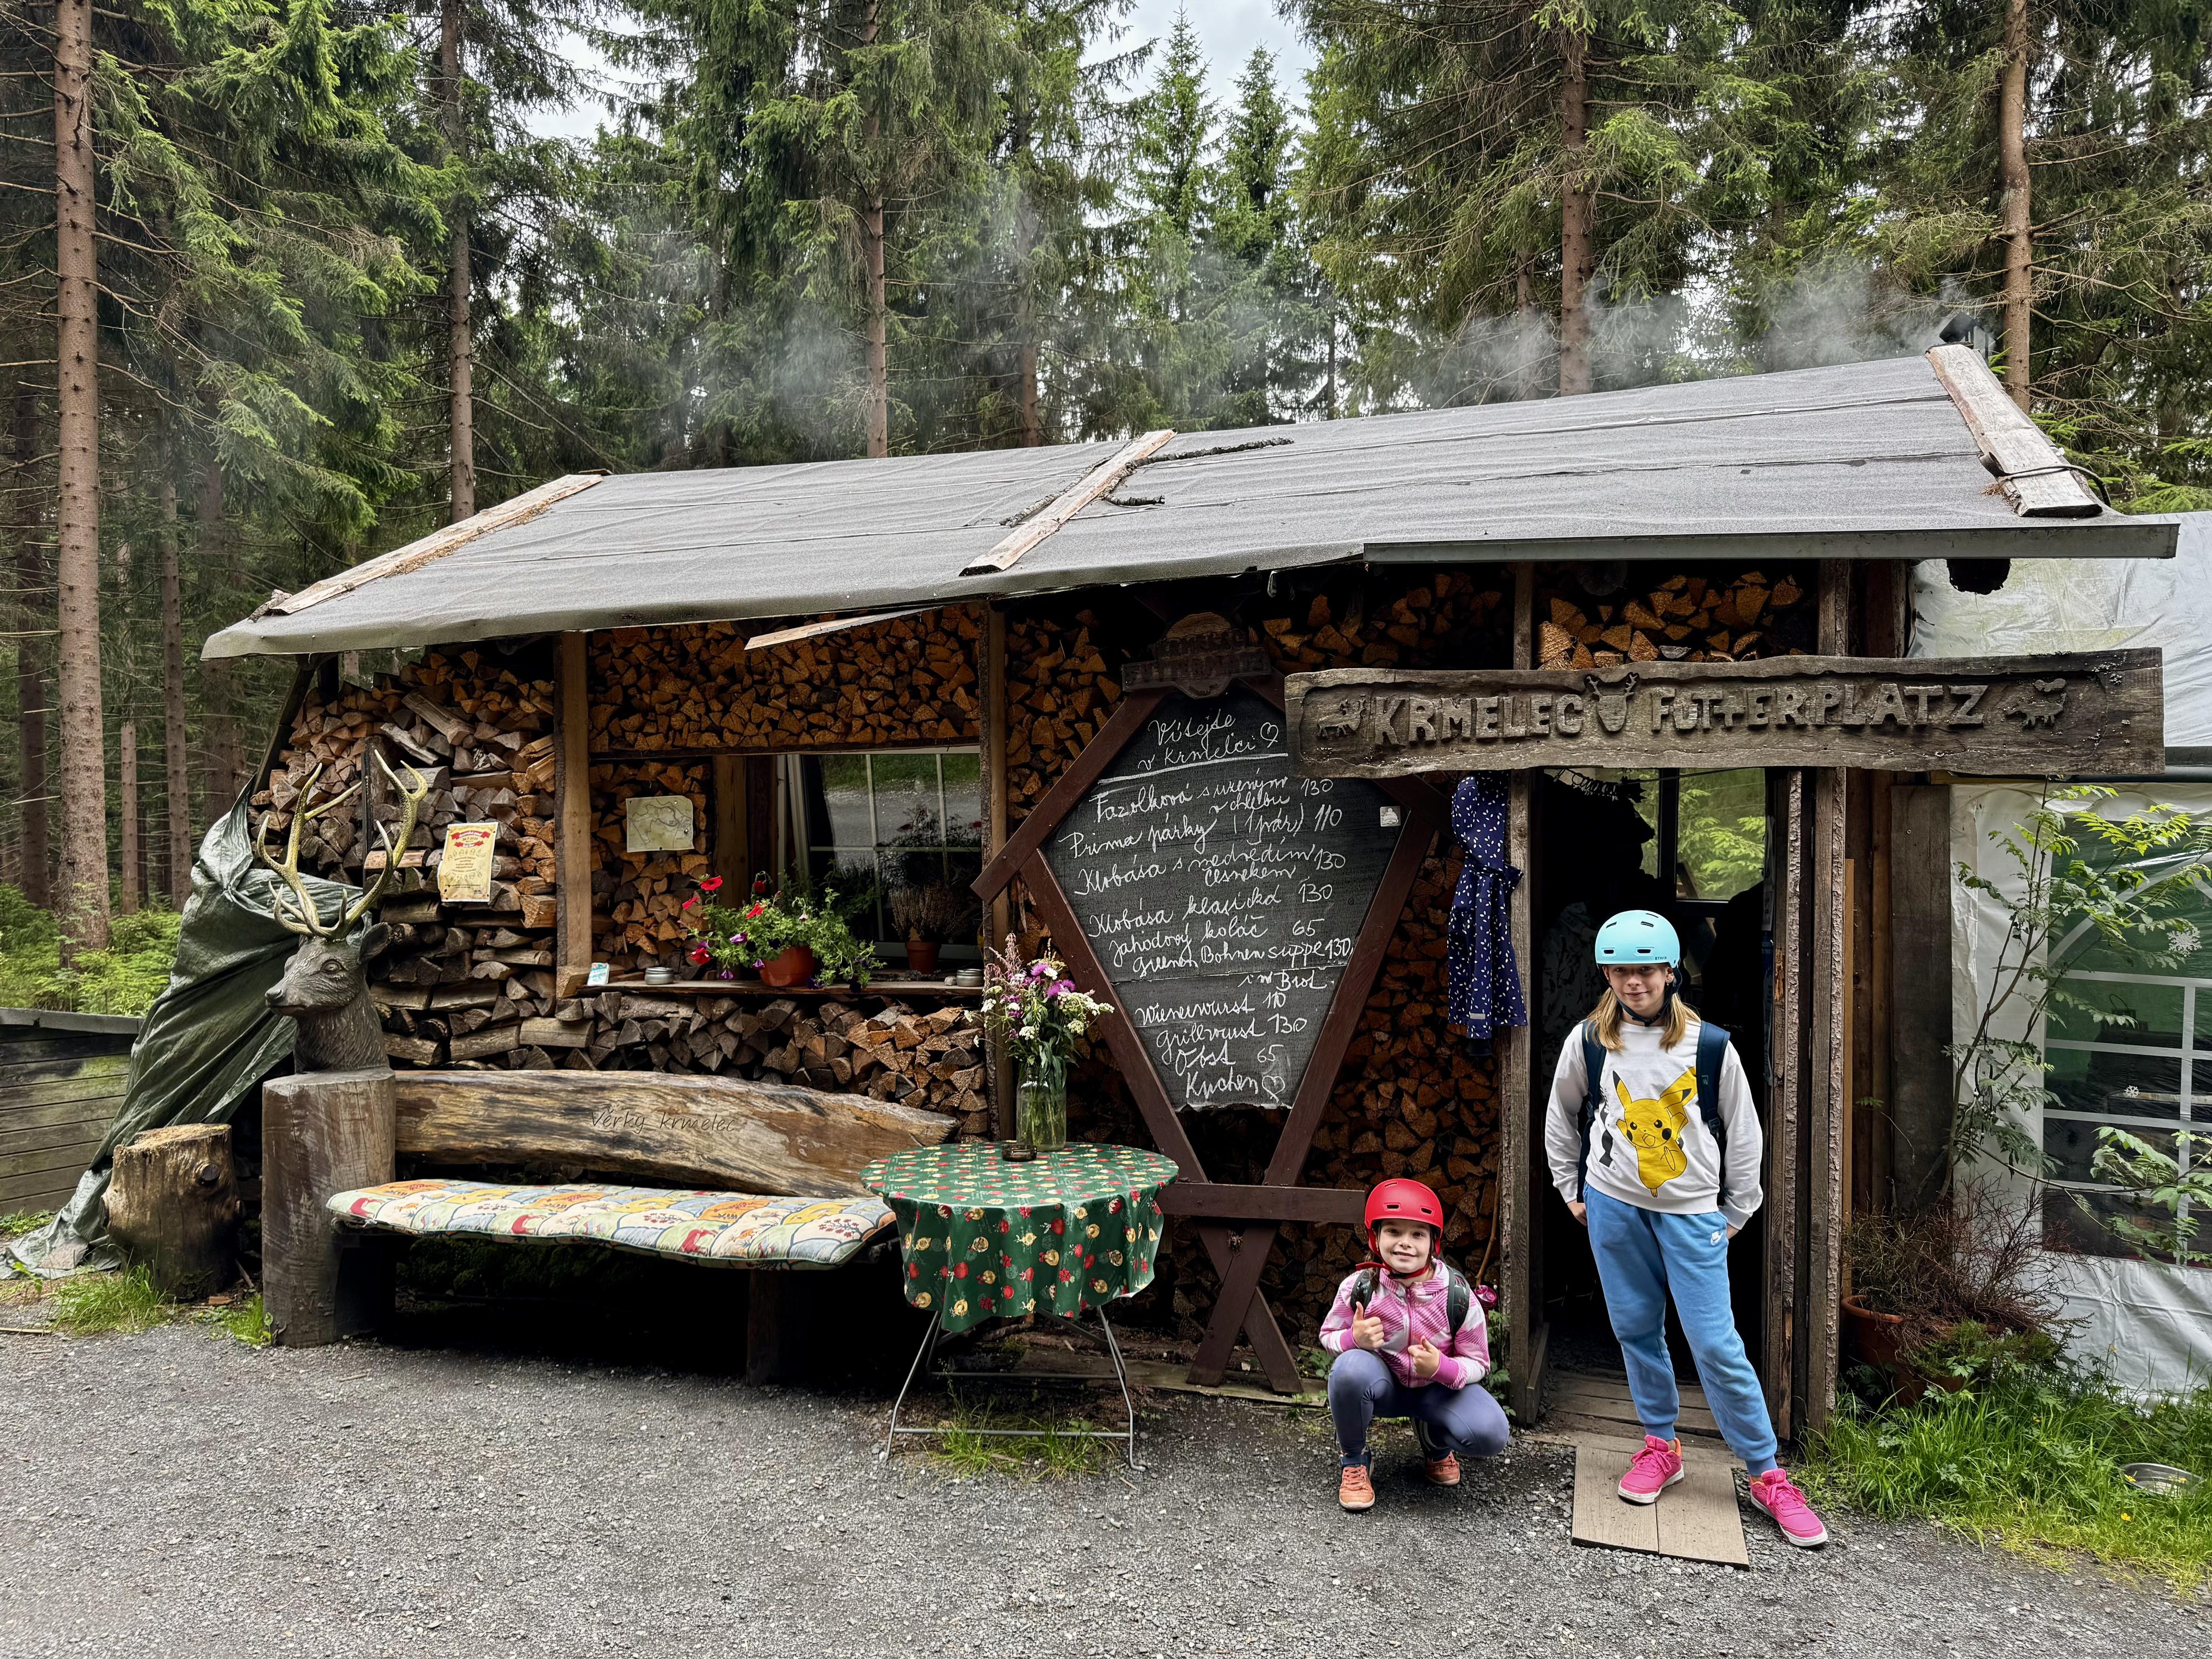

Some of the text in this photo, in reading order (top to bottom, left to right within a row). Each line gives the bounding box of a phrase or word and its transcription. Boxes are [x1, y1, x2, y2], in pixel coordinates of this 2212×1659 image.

[1373, 684, 1990, 748] KRMELEC FUTTERPLATZ
[1088, 783, 1193, 823] Fazolková
[1213, 768, 1288, 805] uzeným
[1301, 778, 1333, 796] 130
[1230, 791, 1290, 811] chlebu
[1058, 830, 1142, 858] Prima
[1148, 812, 1217, 855] párky
[1314, 804, 1343, 832] 110
[1074, 854, 1166, 895] Klobása
[1314, 848, 1345, 870] 130
[1088, 898, 1173, 937] Klobása
[1298, 883, 1333, 902] 130
[1201, 915, 1268, 943] koláč
[1292, 919, 1325, 936] 65
[1267, 1013, 1307, 1034] 130
[1176, 1040, 1284, 1076] Obst 65
[1186, 1066, 1259, 1099] Kuchen
[590, 1108, 735, 1134] Věrky krmelec
